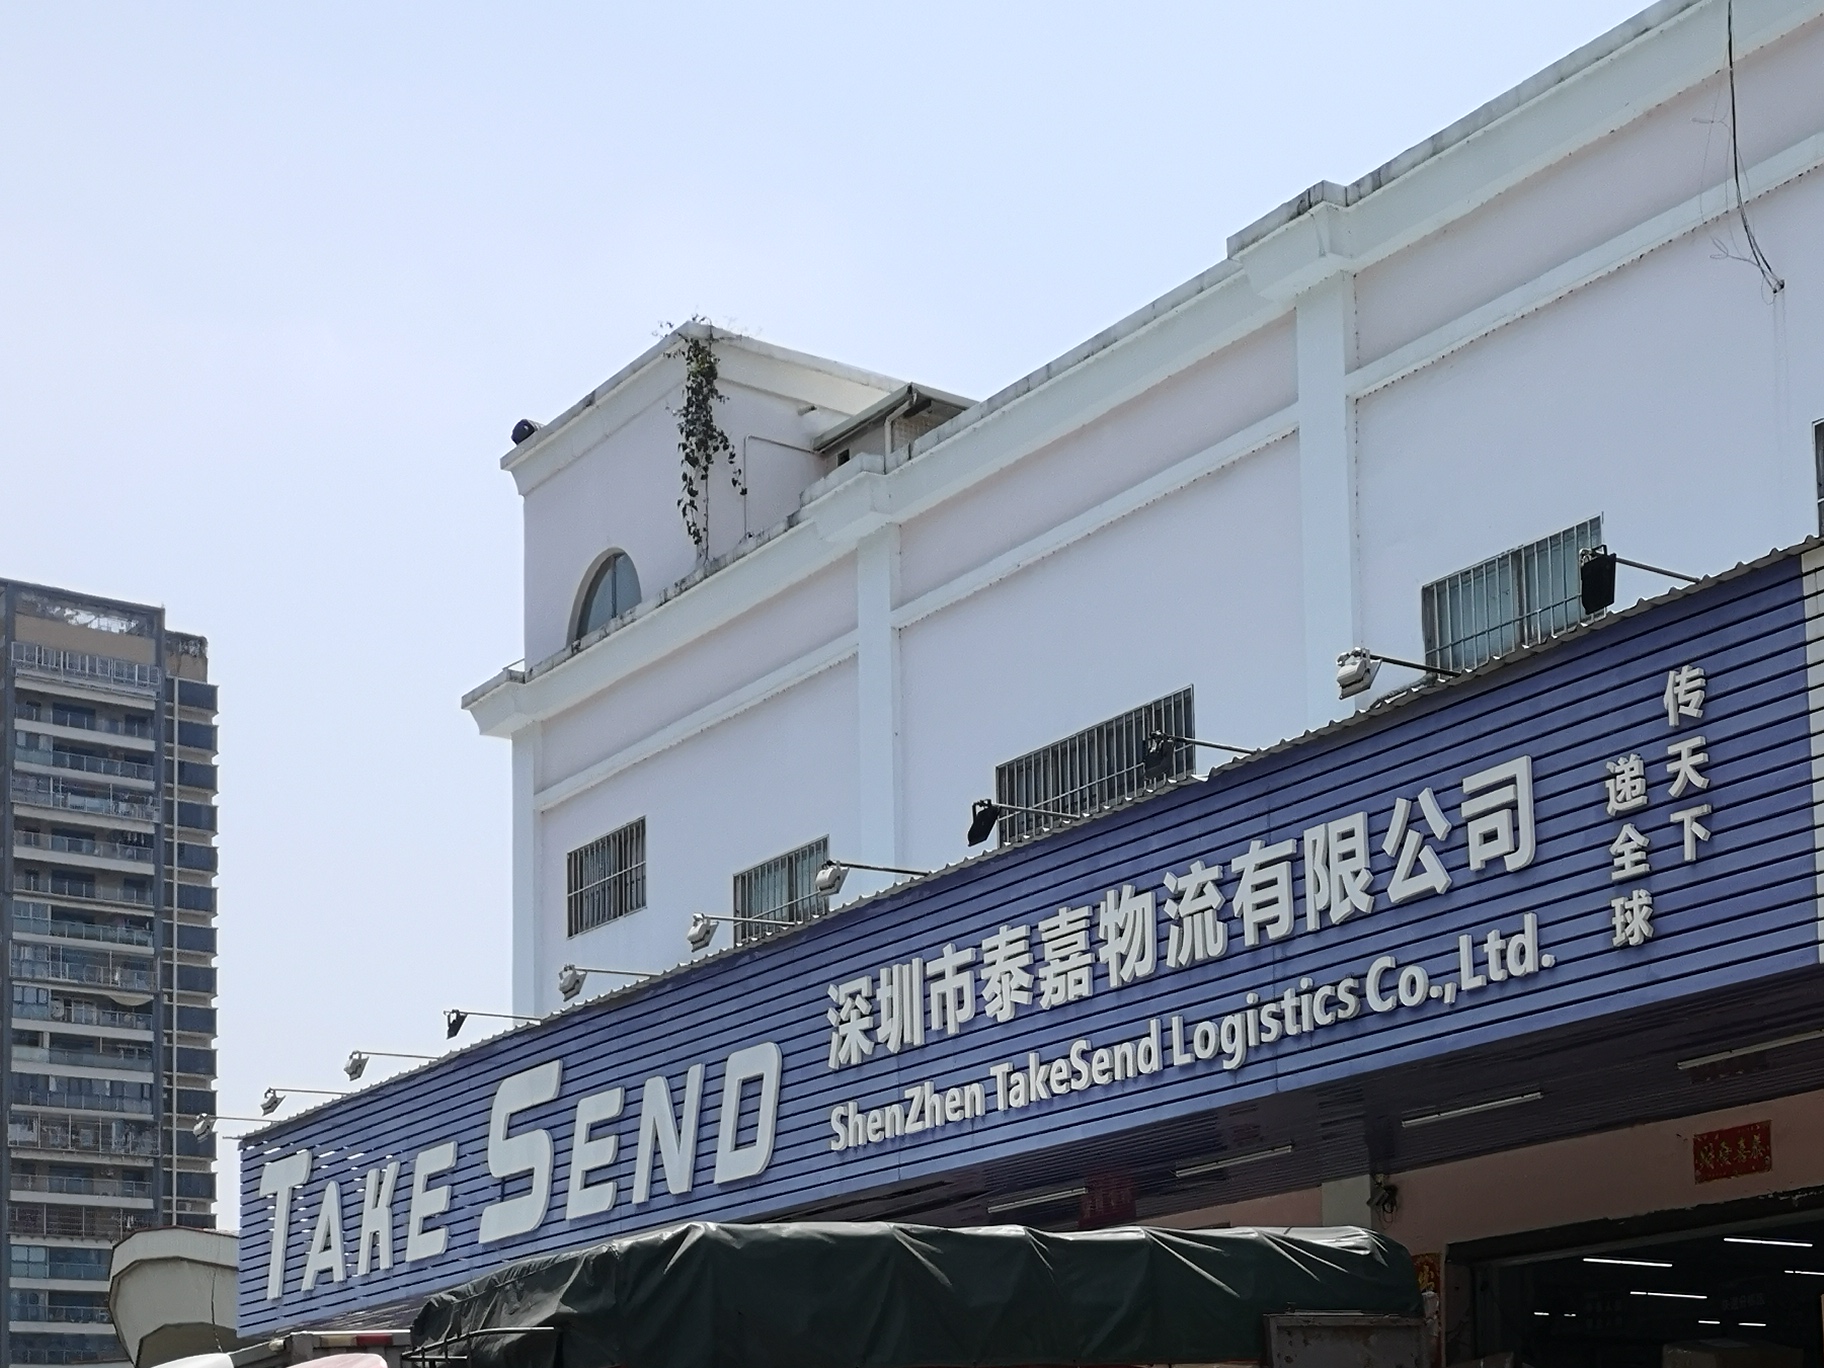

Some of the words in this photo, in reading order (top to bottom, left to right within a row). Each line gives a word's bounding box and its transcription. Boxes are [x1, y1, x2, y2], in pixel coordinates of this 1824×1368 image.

[1603, 751, 1654, 949] 递全球
[1662, 664, 1712, 863] 传天下
[826, 753, 1538, 1070] 深圳市泰嘉物流有限公司
[829, 1073, 986, 1152] ShenZhen
[989, 1016, 1161, 1110] TakeSend
[1171, 972, 1361, 1072] Logistics
[1364, 911, 1557, 1014] Co.,Ltd.
[258, 1141, 458, 1300] TAKE
[478, 1040, 784, 1245] SEND
